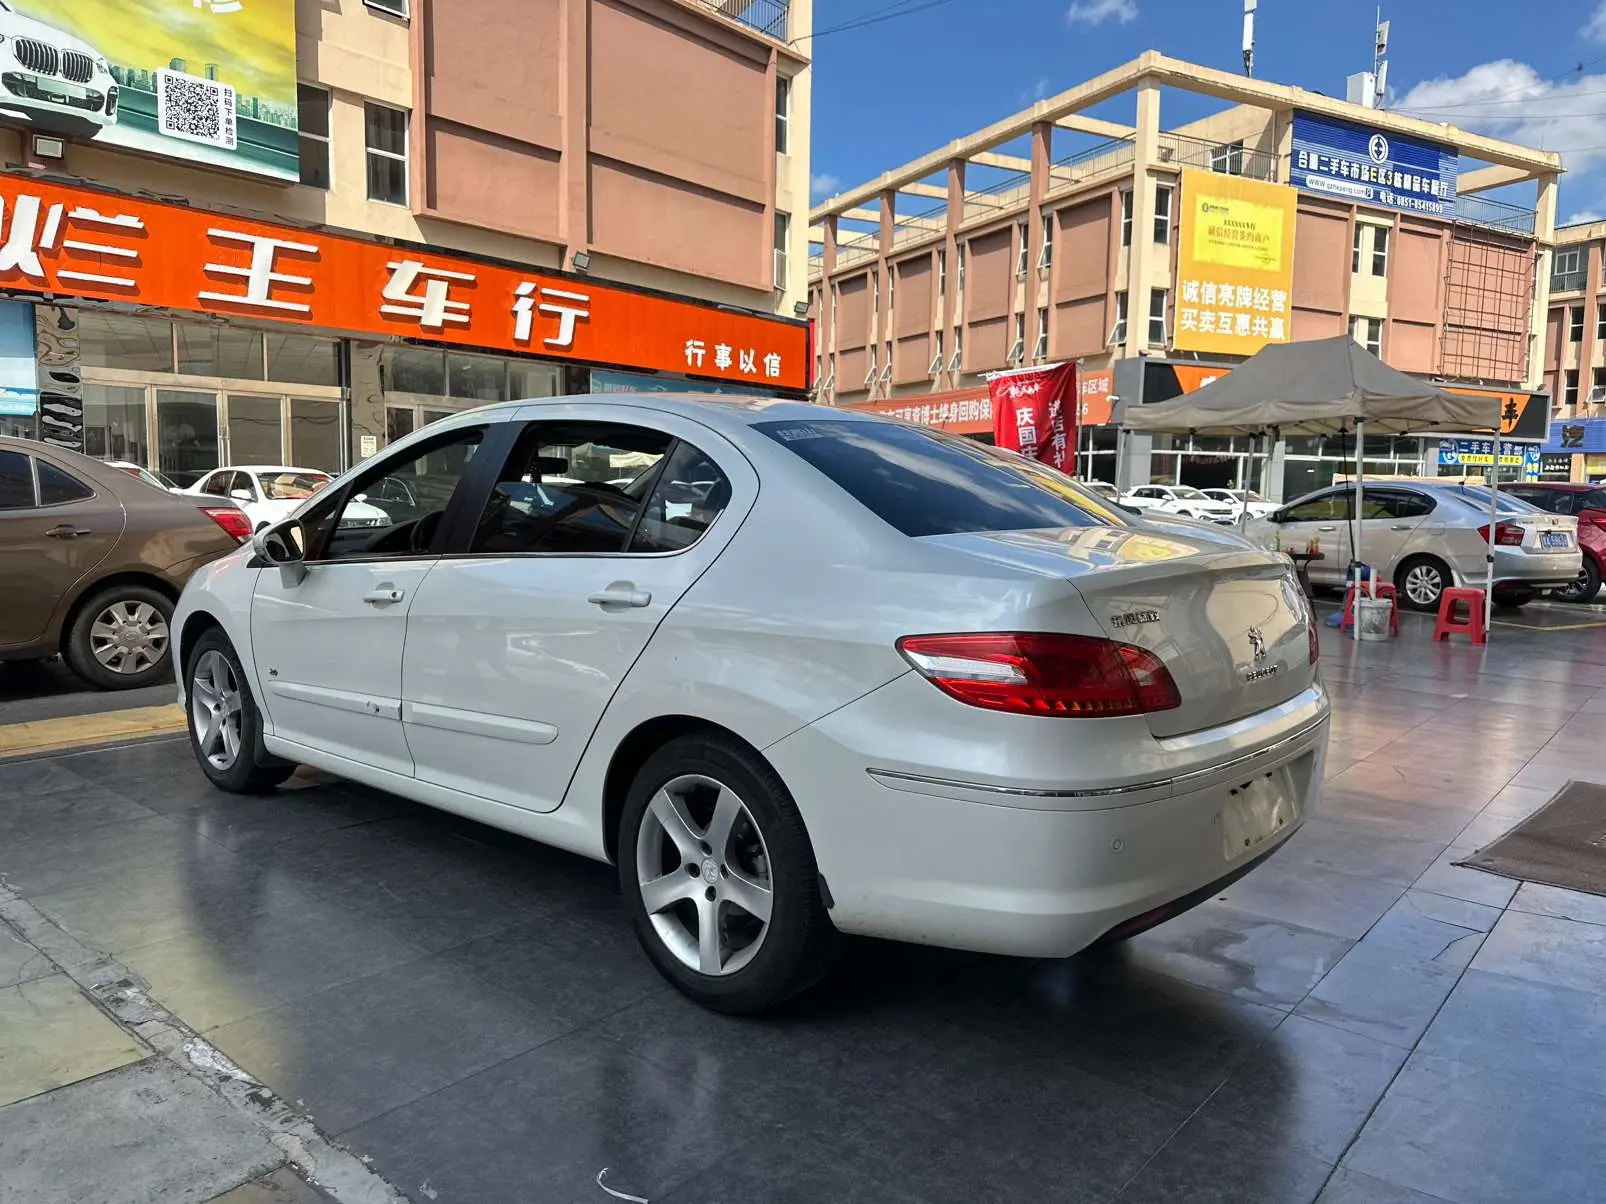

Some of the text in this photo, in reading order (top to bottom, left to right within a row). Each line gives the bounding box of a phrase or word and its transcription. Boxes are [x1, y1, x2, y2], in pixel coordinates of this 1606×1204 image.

[223, 87, 234, 146] 扫码下单检测
[1182, 279, 1287, 313] 诚信亮牌经营
[1181, 308, 1287, 341] 买卖互惠共赢
[685, 339, 782, 377] 行事以信
